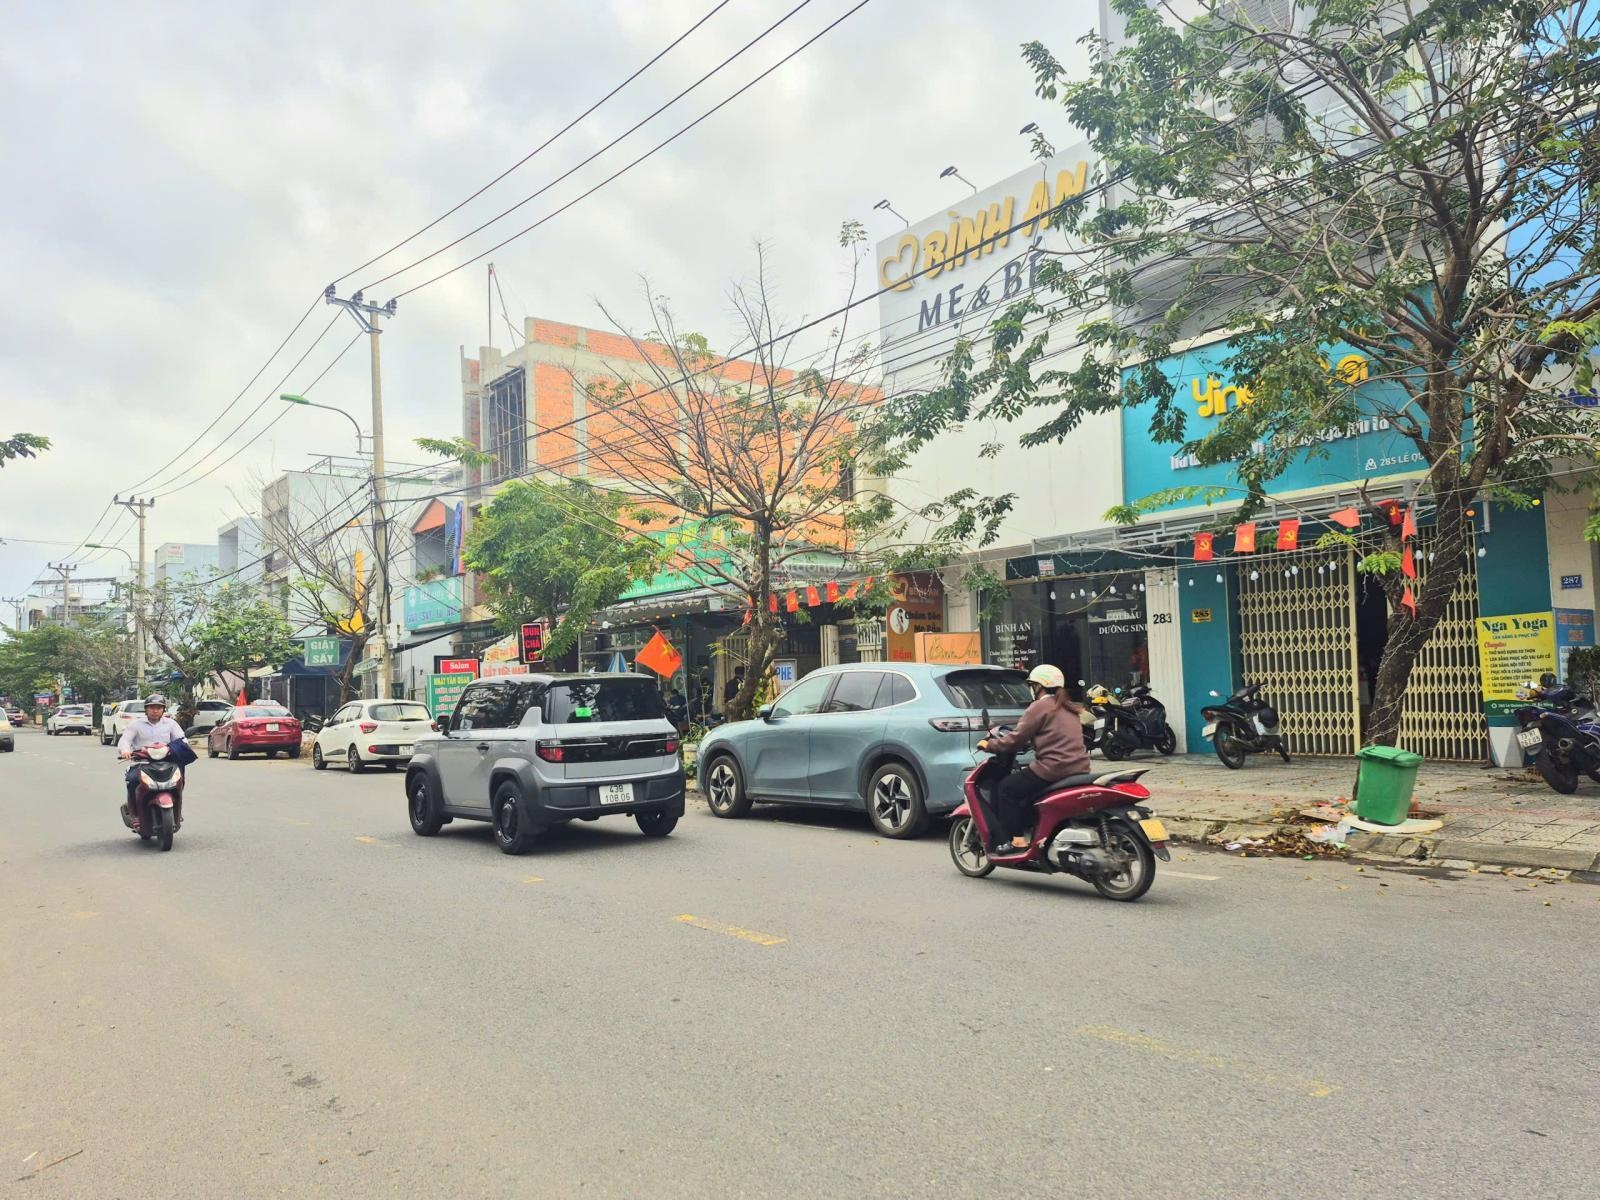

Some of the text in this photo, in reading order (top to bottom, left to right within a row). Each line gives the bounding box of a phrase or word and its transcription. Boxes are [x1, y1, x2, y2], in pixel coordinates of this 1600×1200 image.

[923, 160, 1088, 280] BÌNH AN
[971, 285, 991, 311] &
[1380, 457, 1397, 467] 285
[1153, 613, 1172, 624] 283
[1018, 622, 1031, 632] AN
[1099, 624, 1129, 635] DƯỠNG
[1482, 620, 1507, 633] Nga
[1512, 618, 1548, 631] Yoga
[449, 662, 470, 670] Salon
